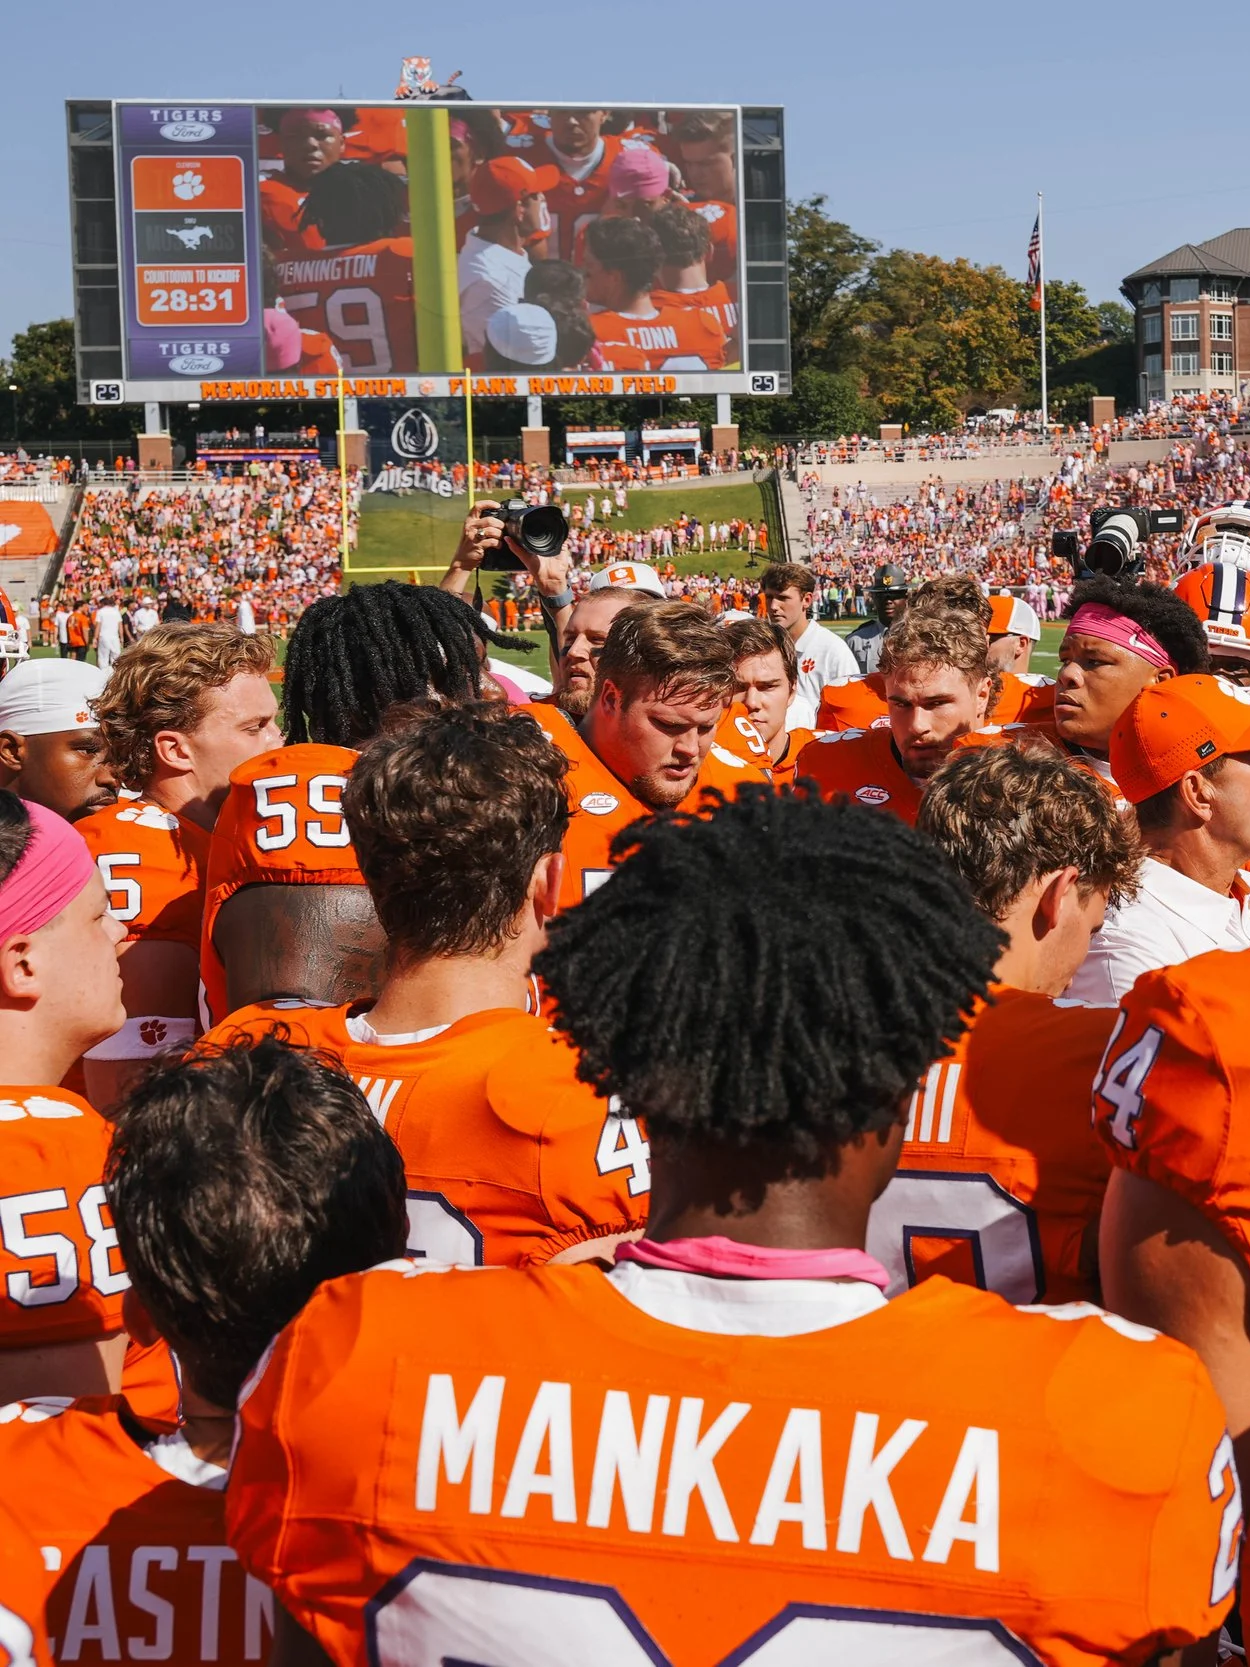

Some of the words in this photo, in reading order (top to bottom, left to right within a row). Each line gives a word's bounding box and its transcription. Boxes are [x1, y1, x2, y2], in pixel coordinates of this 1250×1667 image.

[150, 109, 223, 122] TIGERS
[171, 125, 205, 138] Ford
[150, 288, 234, 312] 28:31
[159, 342, 231, 355] TIGERS
[180, 358, 212, 371] Ford
[200, 380, 310, 399] MEMORIAL
[314, 378, 407, 398] STADIUM
[527, 376, 614, 395] HOWARD
[622, 375, 676, 395] FIELD
[751, 375, 774, 392] 25
[97, 385, 119, 401] 25
[1207, 624, 1240, 637] TIGERS
[734, 715, 766, 755] 9
[586, 797, 613, 806] ACC
[860, 788, 886, 800] ACC
[594, 1094, 651, 1199] 4
[0, 1184, 131, 1308] 58
[414, 1373, 999, 1573] MANKAKA
